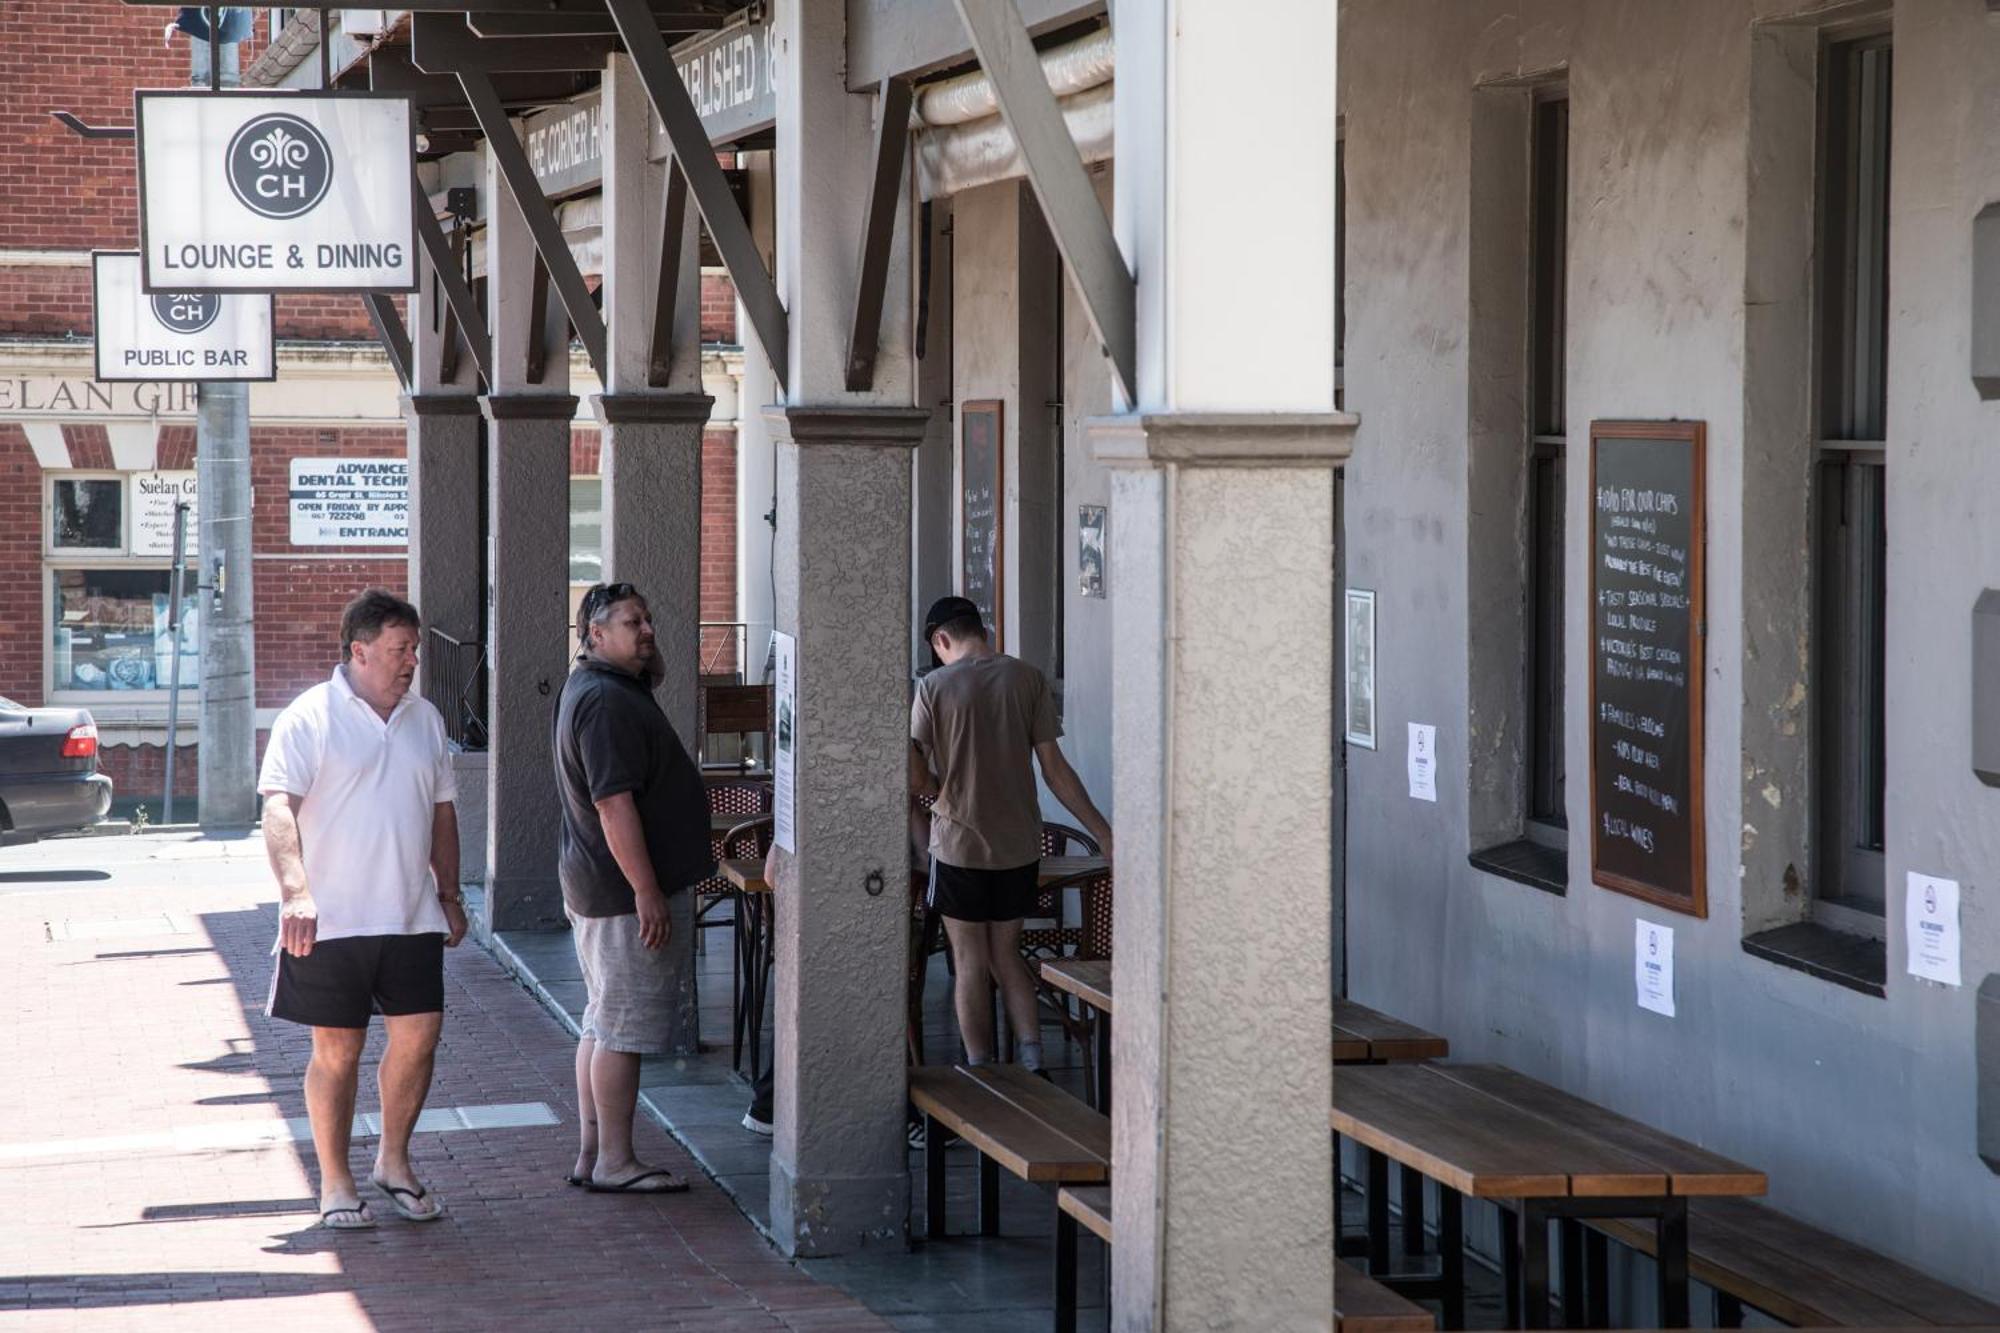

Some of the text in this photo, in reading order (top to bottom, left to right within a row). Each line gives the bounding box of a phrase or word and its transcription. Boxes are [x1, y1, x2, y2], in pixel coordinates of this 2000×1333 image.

[548, 111, 588, 174] CORNER
[256, 174, 306, 198] CH
[164, 243, 403, 269] LOUNGE & DINING
[169, 305, 204, 321] CH
[124, 349, 248, 367] PUBLIC BAR
[336, 463, 408, 474] ADVANCE
[140, 478, 178, 494] Suelan
[298, 475, 356, 486] DENTAL
[297, 503, 322, 511] OPEN
[327, 503, 361, 511] FRIDAY
[367, 503, 379, 511] BY
